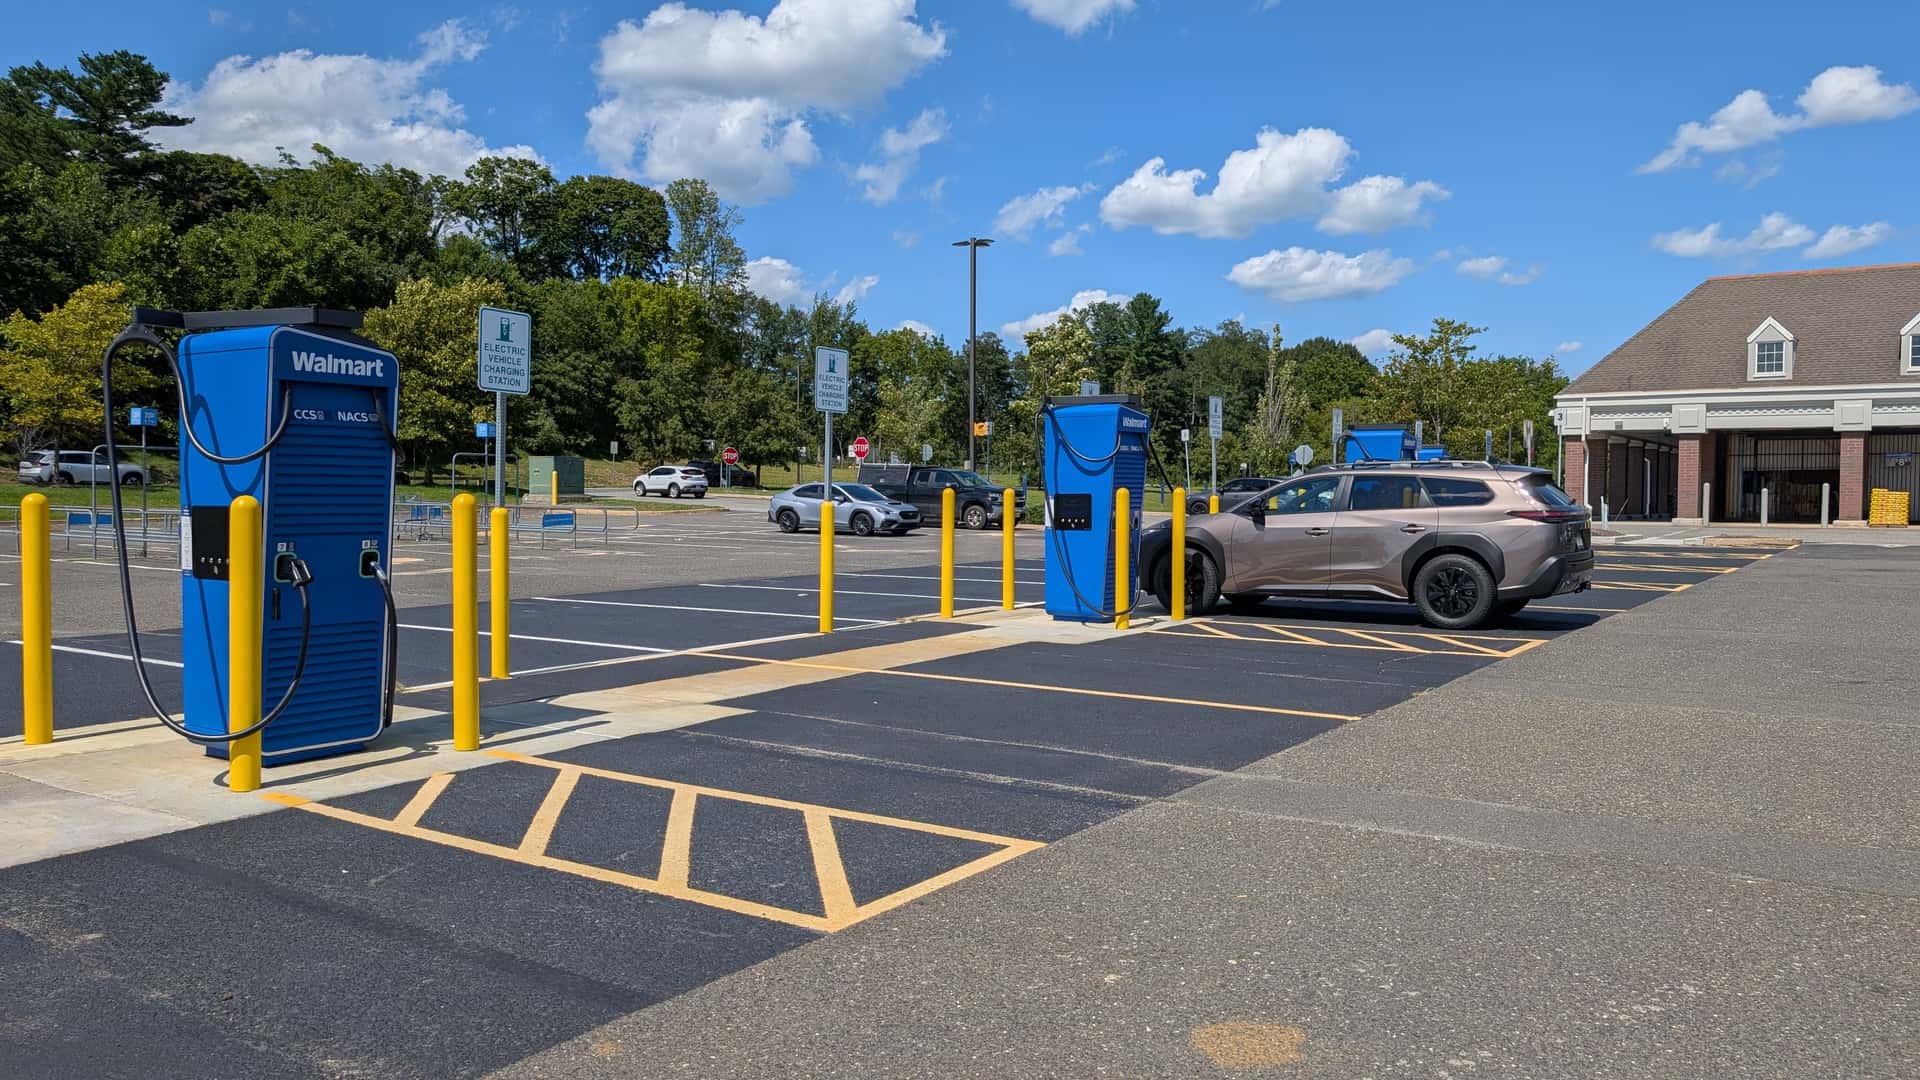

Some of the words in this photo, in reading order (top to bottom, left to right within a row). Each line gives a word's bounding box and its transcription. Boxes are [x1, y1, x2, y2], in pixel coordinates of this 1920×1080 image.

[484, 343, 526, 356] ELECTRIC
[292, 351, 384, 377] Walmart
[488, 354, 522, 366] VEHICLE
[484, 364, 525, 377] CHARGING
[488, 375, 521, 386] STATION
[819, 374, 845, 384] ELECTRIC
[294, 409, 317, 420] CCS
[337, 411, 369, 422] NACS
[1122, 416, 1147, 428] Walmart
[854, 444, 869, 452] STOP
[723, 452, 738, 460] STOP
